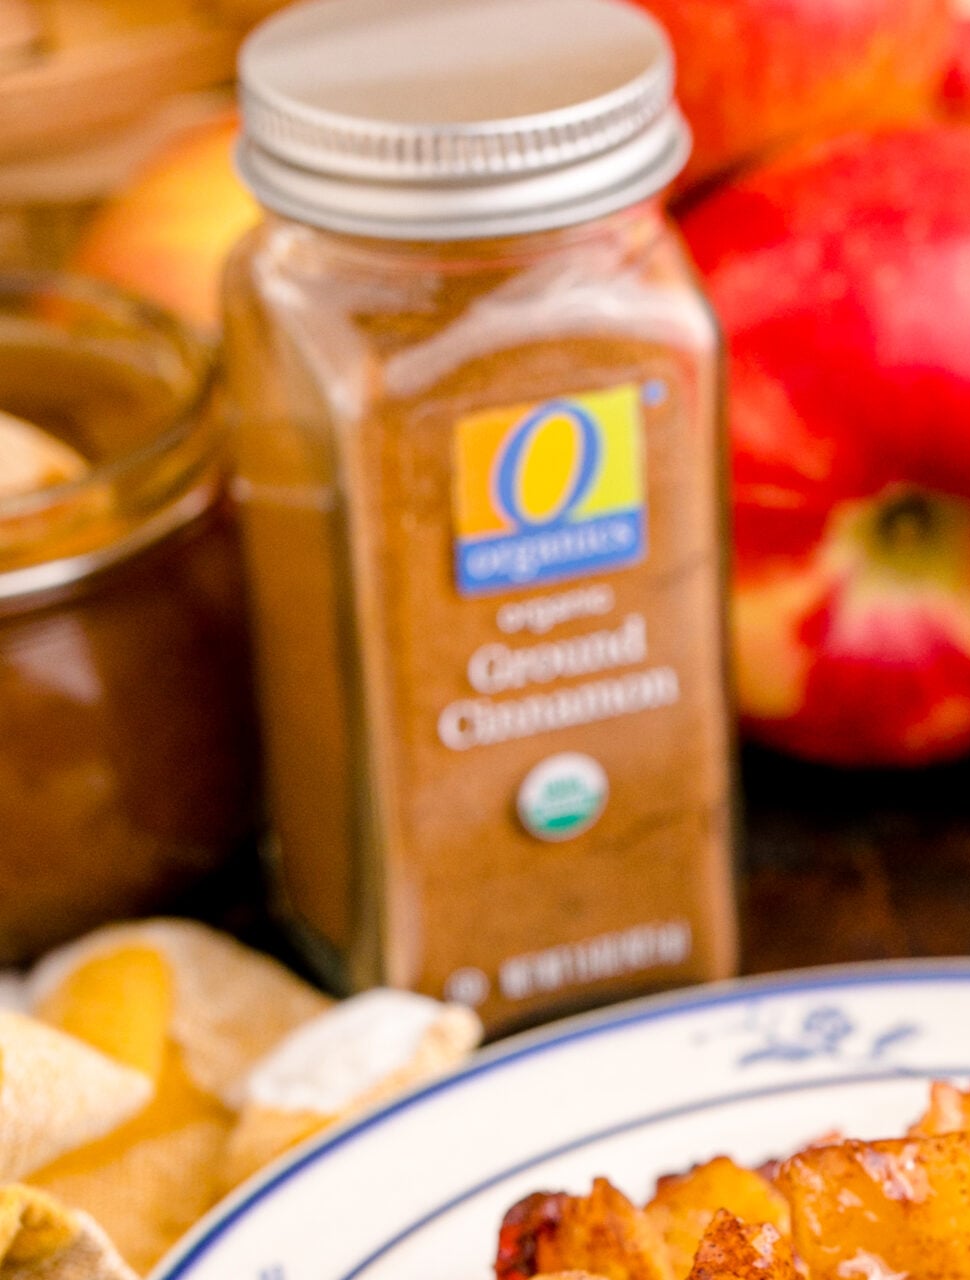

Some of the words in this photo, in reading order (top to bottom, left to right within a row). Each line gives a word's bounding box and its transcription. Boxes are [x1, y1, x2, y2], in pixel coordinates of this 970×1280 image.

[493, 397, 604, 527] O
[466, 520, 634, 582] organics
[497, 584, 614, 633] organic
[467, 613, 646, 694] Ground
[437, 666, 678, 750] Cinnamon
